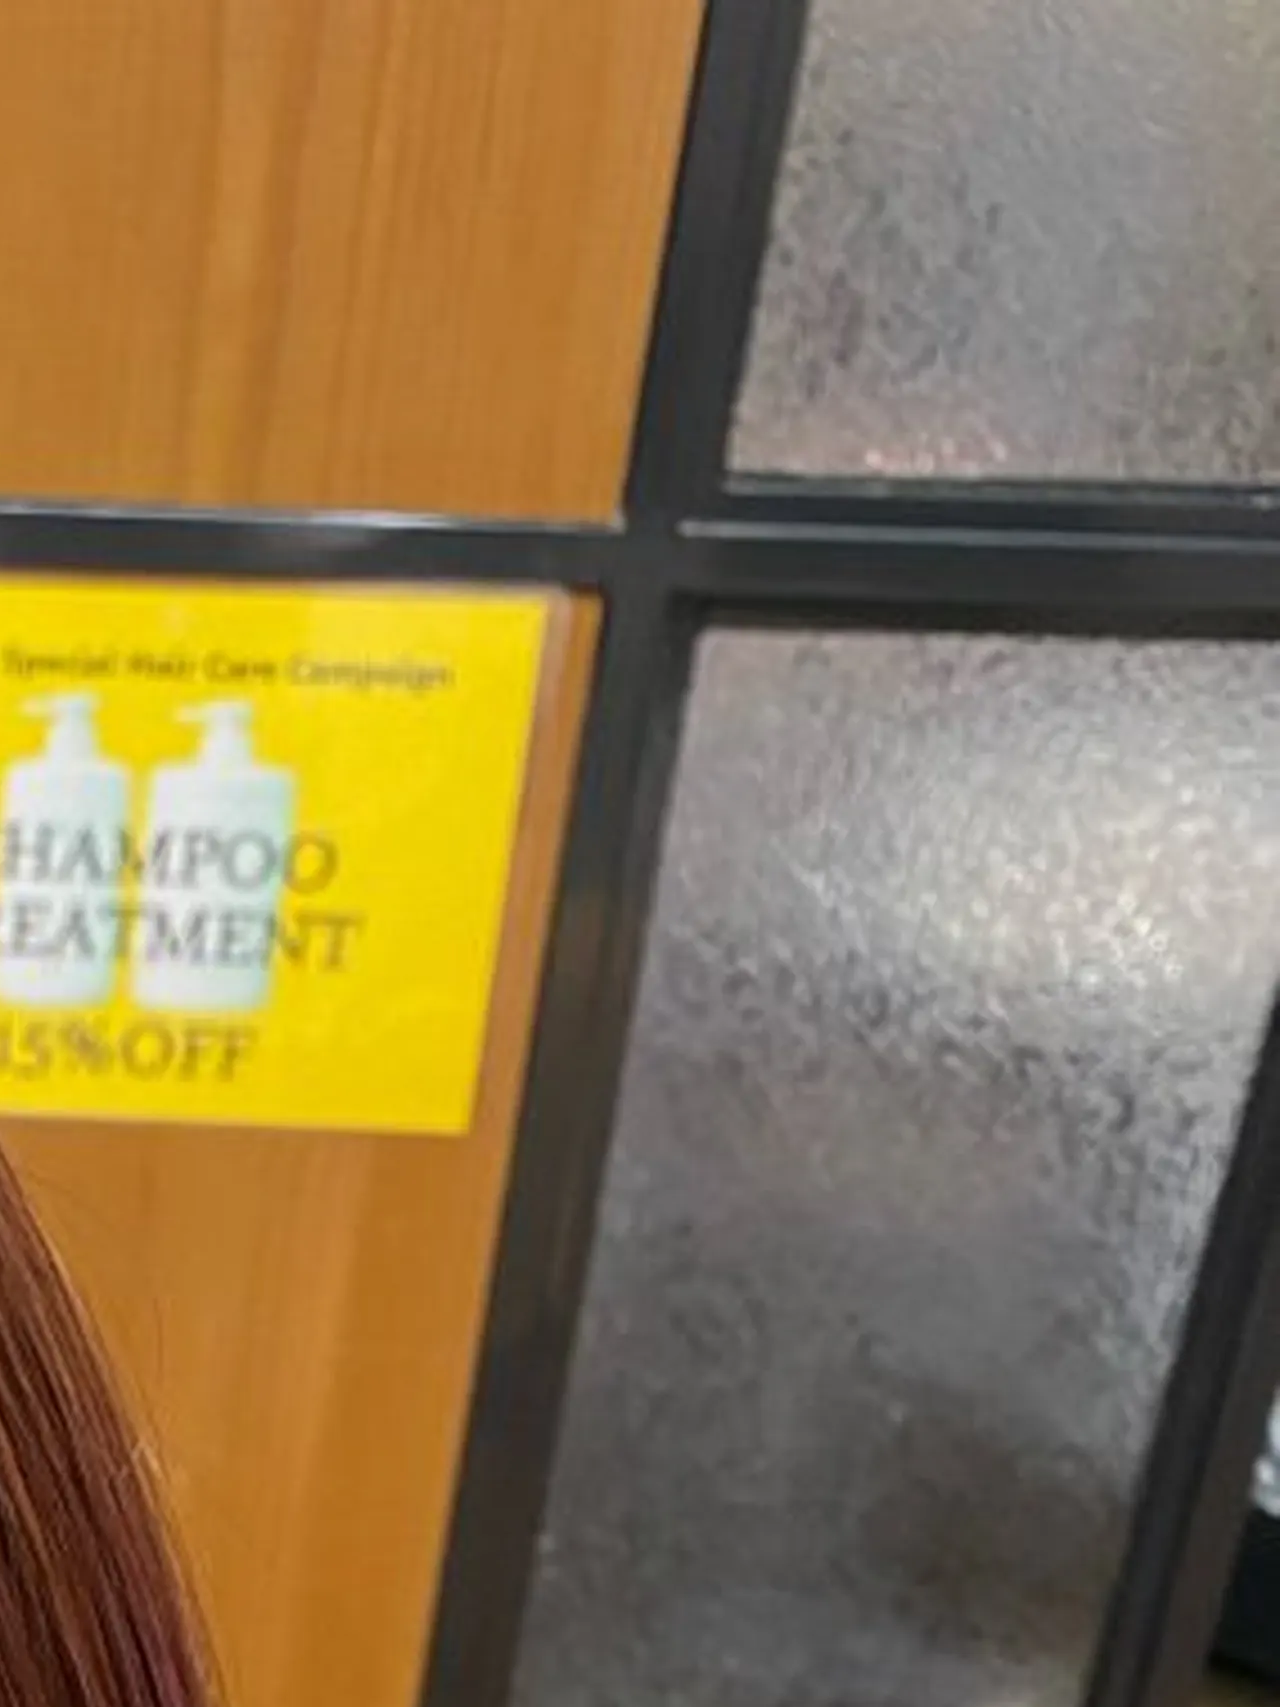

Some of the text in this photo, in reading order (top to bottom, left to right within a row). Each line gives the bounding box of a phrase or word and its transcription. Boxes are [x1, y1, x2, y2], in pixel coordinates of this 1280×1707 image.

[2, 644, 118, 683] Special
[127, 646, 196, 681] Hair
[203, 650, 278, 686] Care
[285, 653, 456, 693] Campaign
